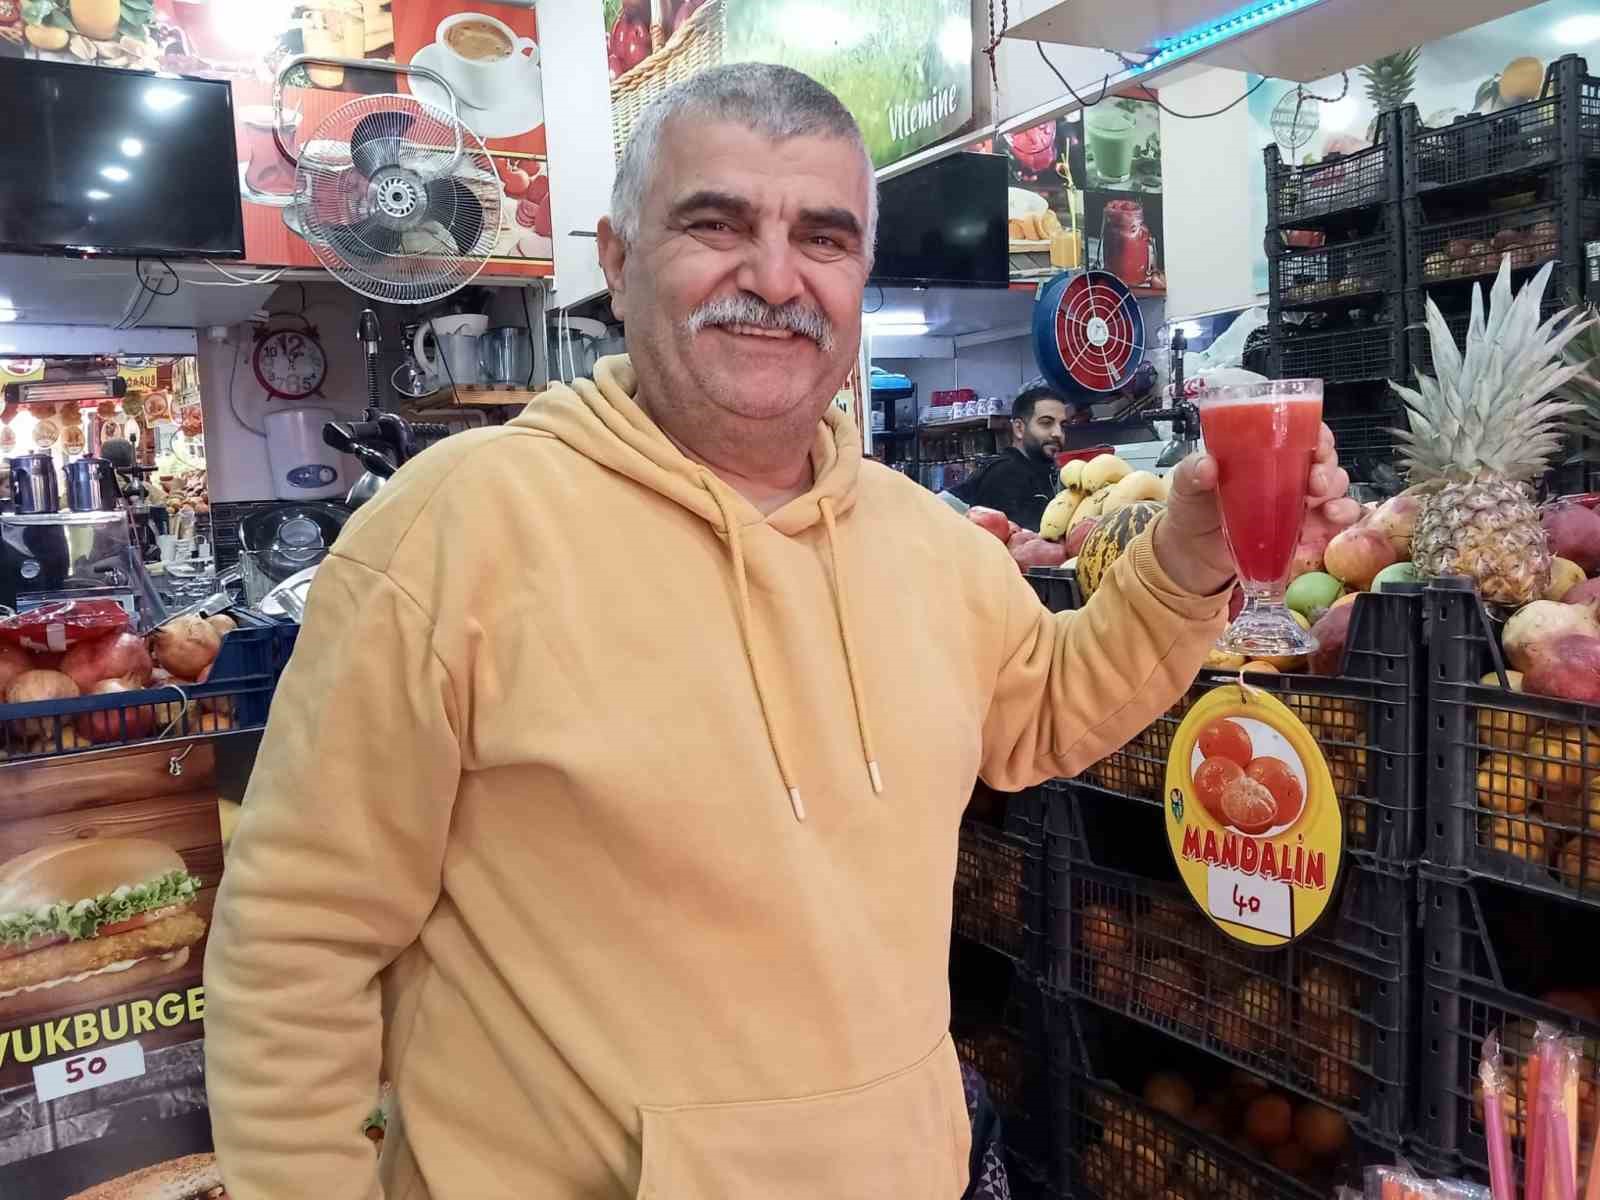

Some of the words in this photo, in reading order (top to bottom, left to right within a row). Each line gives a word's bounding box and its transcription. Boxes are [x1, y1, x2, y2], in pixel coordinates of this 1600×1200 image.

[1182, 824, 1327, 890] MANDALİN
[1233, 884, 1261, 917] 40
[65, 1056, 107, 1084] 50
